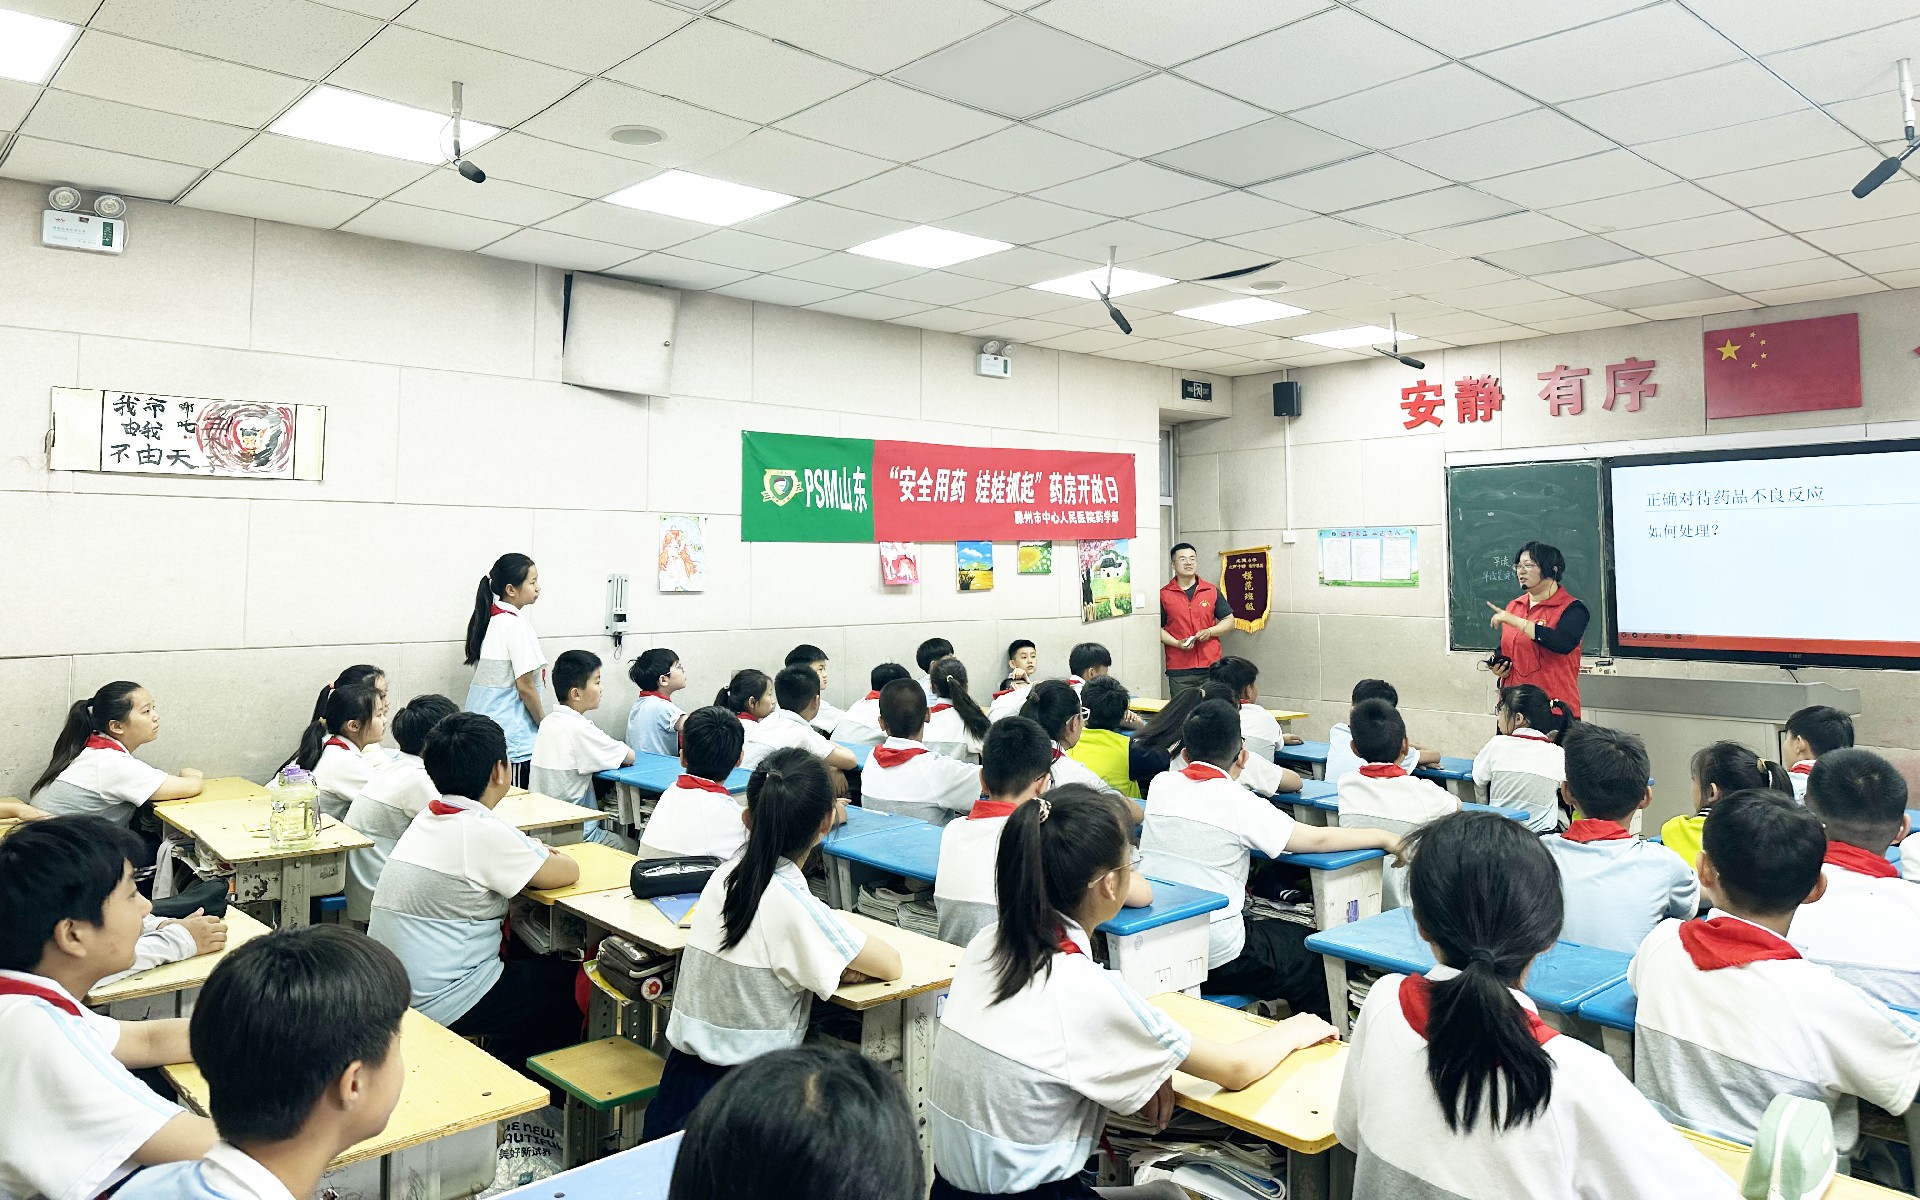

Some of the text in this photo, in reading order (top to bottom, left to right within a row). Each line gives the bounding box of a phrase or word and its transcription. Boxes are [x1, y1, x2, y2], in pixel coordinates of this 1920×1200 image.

[1400, 357, 1659, 430] 安静 有序
[113, 394, 167, 418] 我命
[121, 417, 164, 441] 由我
[110, 443, 200, 470] 不由天
[804, 465, 868, 514] PSM山东
[1048, 471, 1120, 505] 药房开放日
[1646, 486, 1825, 508] 正确对待药品不良反应
[1647, 523, 1719, 539] 如何处理？
[503, 1132, 563, 1150] AUTIFUL
